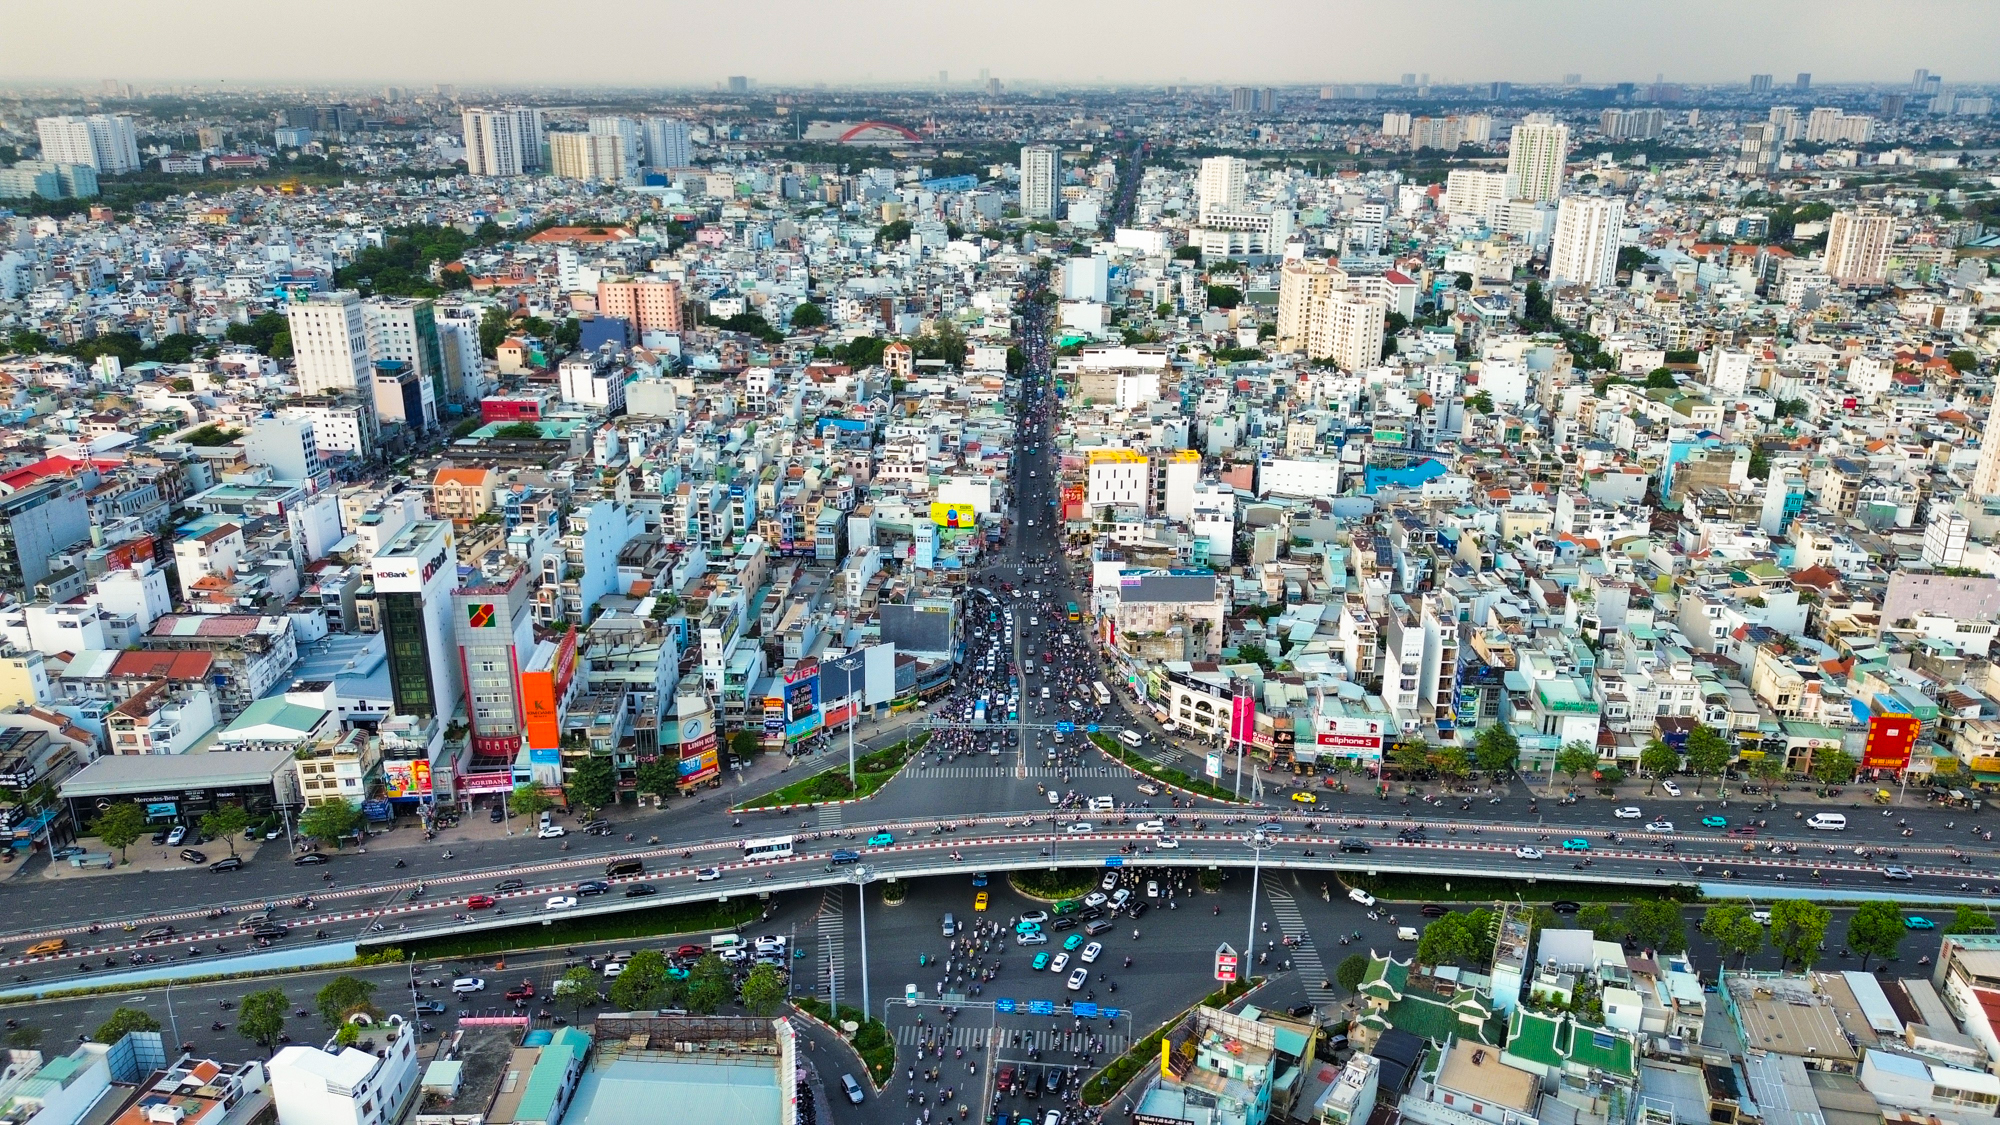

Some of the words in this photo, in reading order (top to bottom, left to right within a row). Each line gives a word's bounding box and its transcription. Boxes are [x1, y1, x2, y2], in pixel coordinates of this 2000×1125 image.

[422, 547, 448, 585] HDBank
[687, 735, 704, 751] LINH
[685, 760, 700, 770] 367
[471, 778, 509, 786] AGRIBANK
[133, 795, 180, 803] Mercedes-Benz
